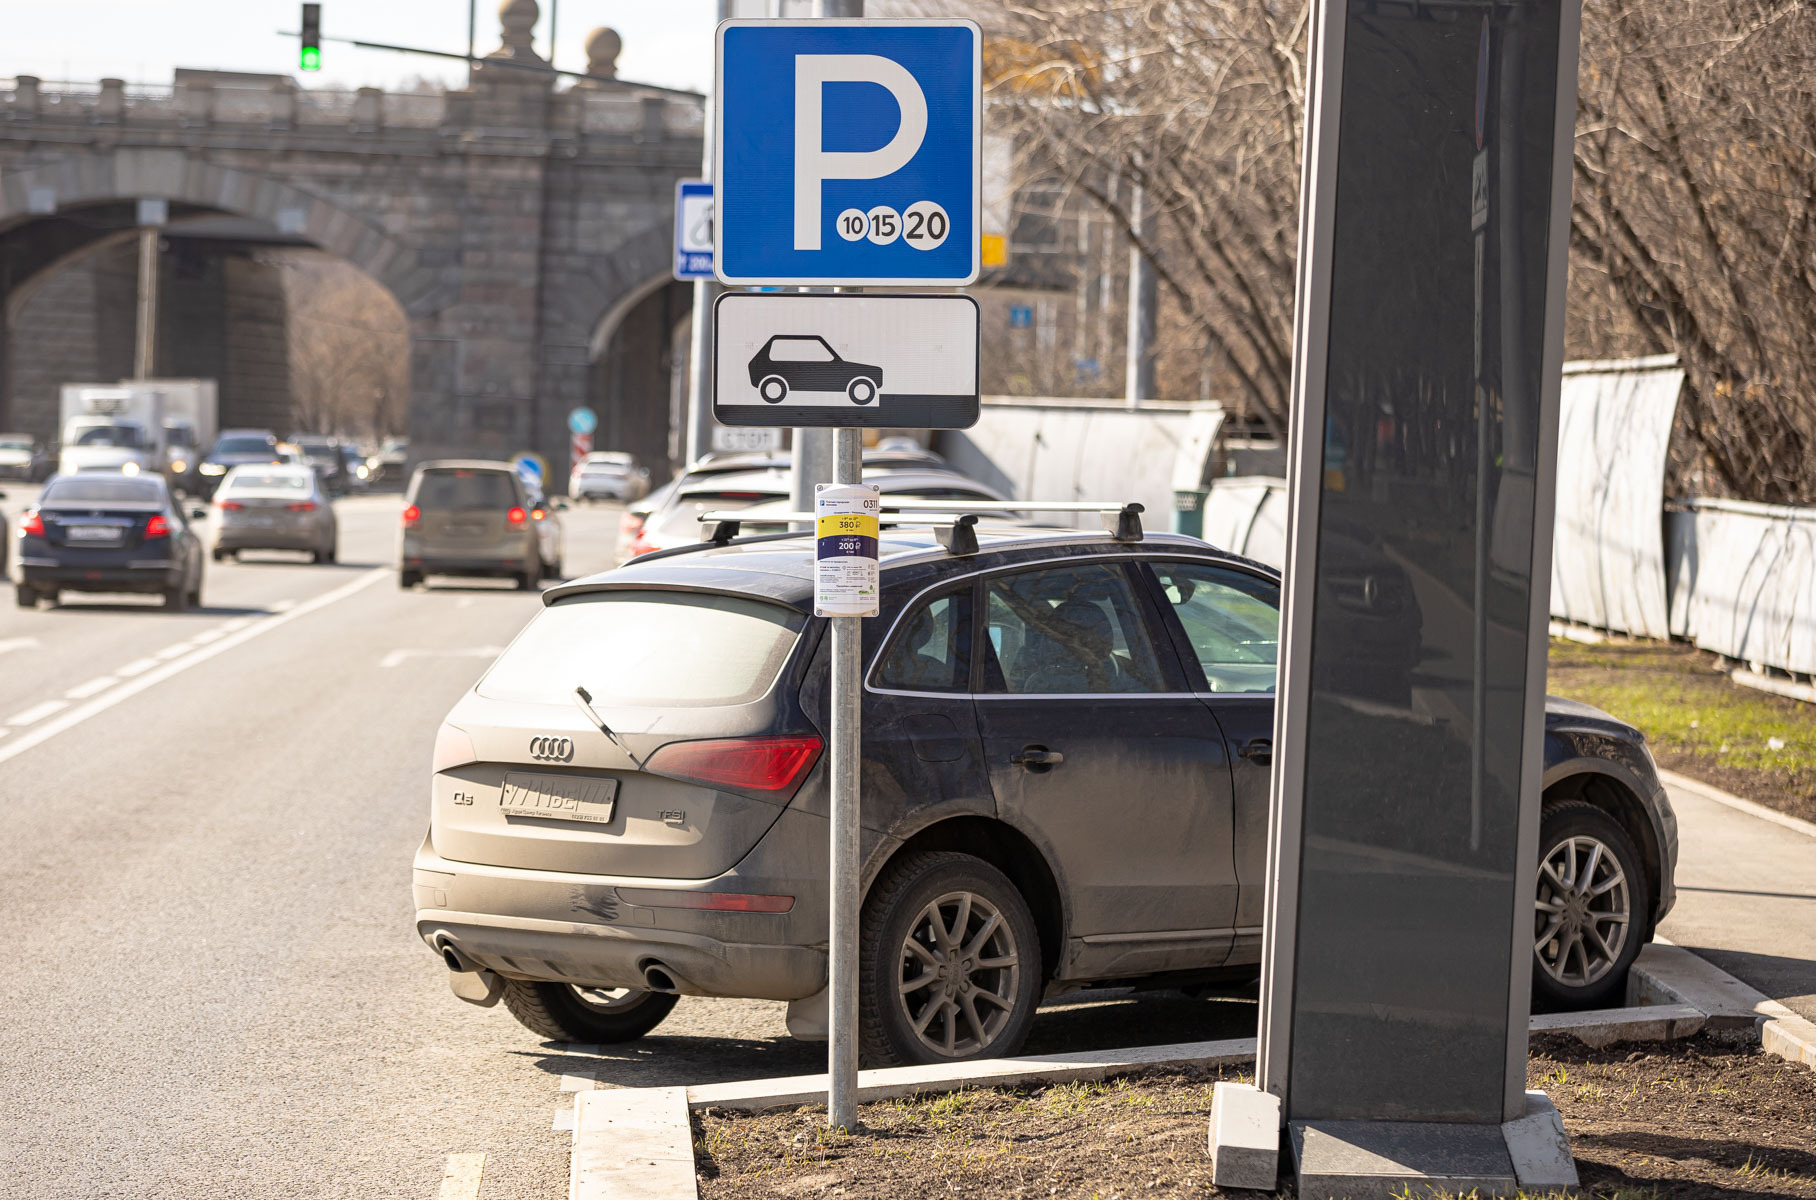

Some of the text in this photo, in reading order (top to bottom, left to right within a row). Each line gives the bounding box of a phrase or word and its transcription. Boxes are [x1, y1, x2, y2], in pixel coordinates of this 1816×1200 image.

[794, 54, 928, 250] P
[843, 211, 946, 240] 10 15 20
[839, 521, 854, 529] 380
[838, 542, 854, 550] 200
[453, 792, 473, 806] Q5
[656, 810, 685, 819] TFSI
